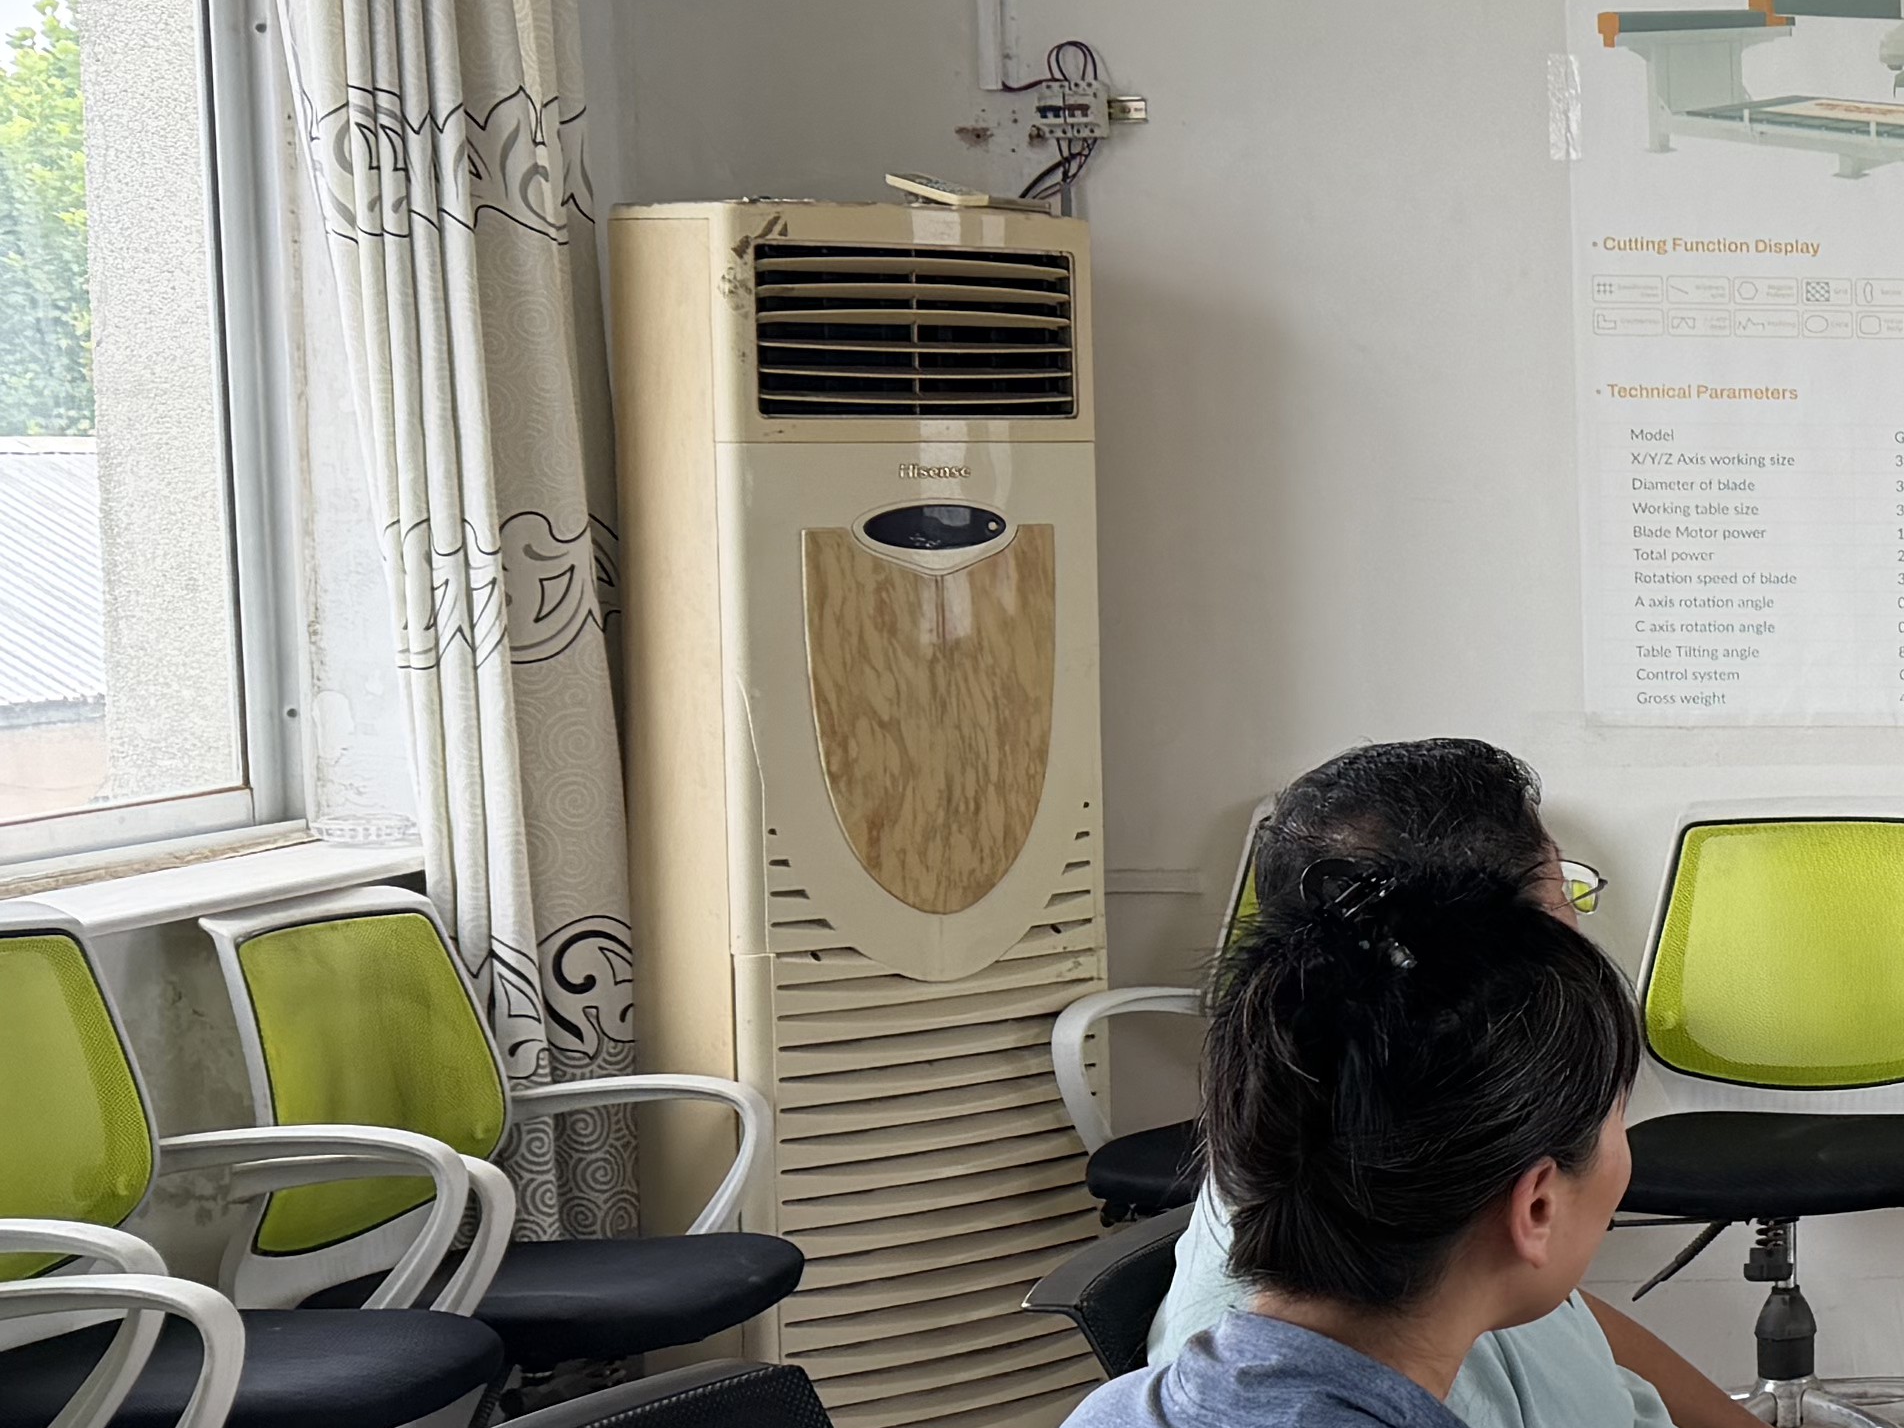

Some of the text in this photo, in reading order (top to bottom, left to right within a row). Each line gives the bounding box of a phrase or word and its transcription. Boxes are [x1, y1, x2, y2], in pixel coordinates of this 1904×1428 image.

[1603, 237, 1821, 257] Cutting Function Display
[1607, 383, 1798, 401] Technical Parameters
[1630, 428, 1675, 442] Model
[1630, 452, 1795, 468] X/Y/Z Axis working size
[1631, 477, 1756, 492] Diameter of blade
[1632, 502, 1760, 517] Working table size
[1632, 525, 1766, 541] Blade Motor power
[1633, 548, 1715, 563] Total power
[1634, 571, 1797, 587] Rotation speed of blade
[1634, 595, 1775, 611] A axis rotation angle
[1635, 620, 1776, 636] C axis rotation angle
[1635, 645, 1760, 661] Table Tilting angle
[1636, 668, 1740, 683] Control system
[1636, 691, 1726, 707] Gross weight
